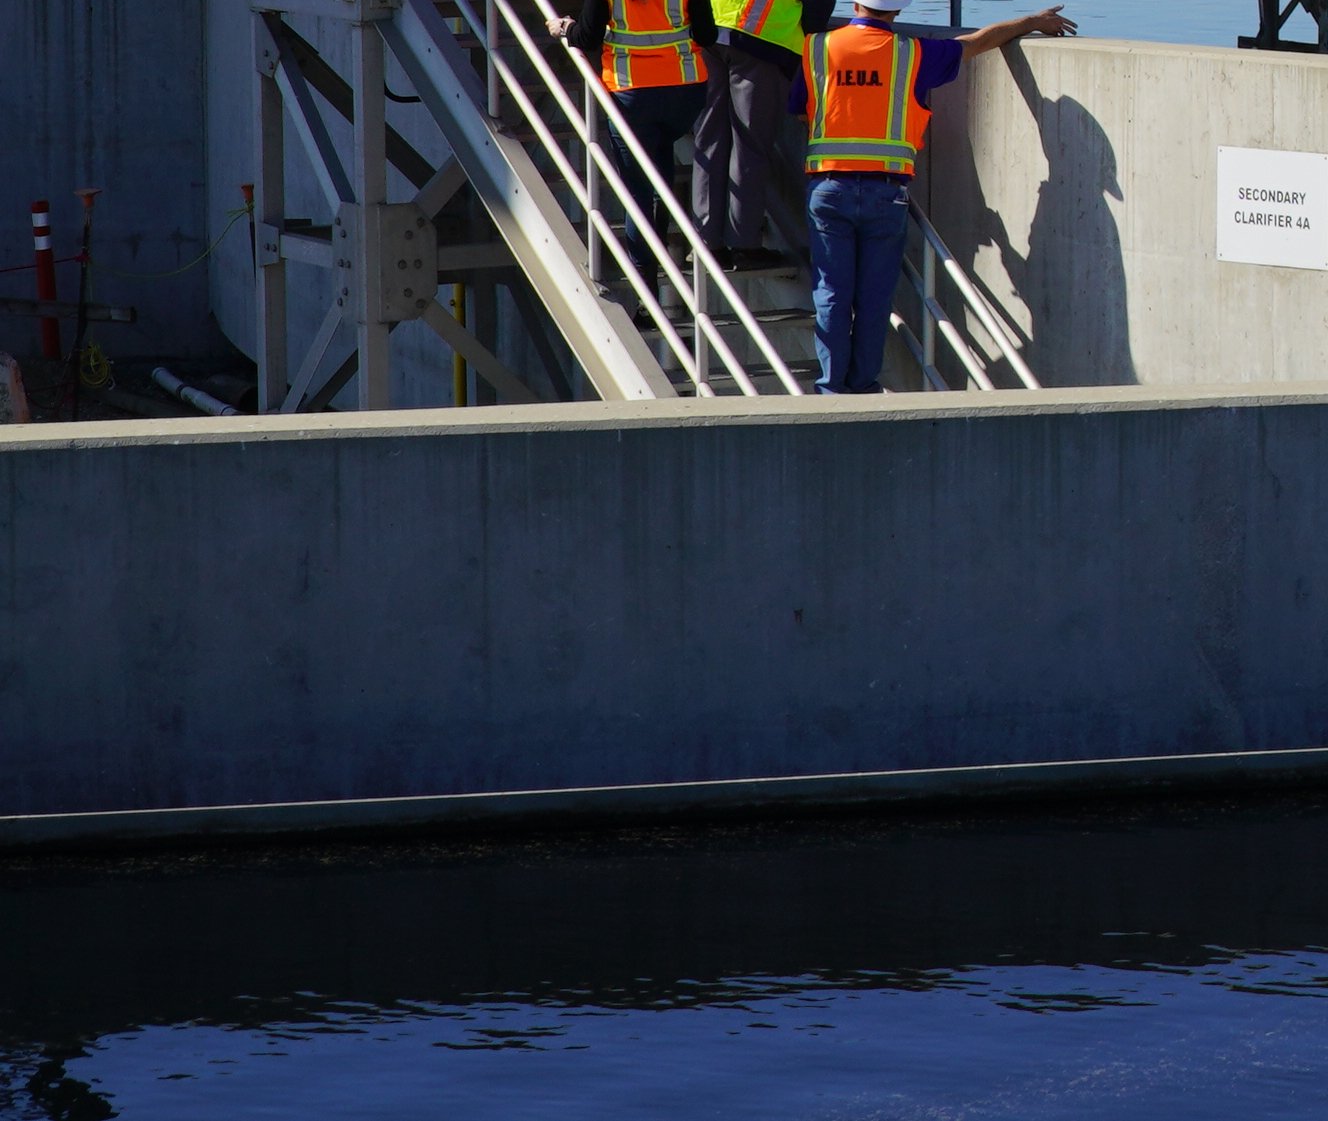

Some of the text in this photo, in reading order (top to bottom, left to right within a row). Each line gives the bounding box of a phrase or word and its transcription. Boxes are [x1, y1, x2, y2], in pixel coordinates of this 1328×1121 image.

[837, 70, 883, 86] I.E.U.A.
[1238, 187, 1306, 205] SECONDARY
[1234, 211, 1310, 229] CLARIFIER 4A
